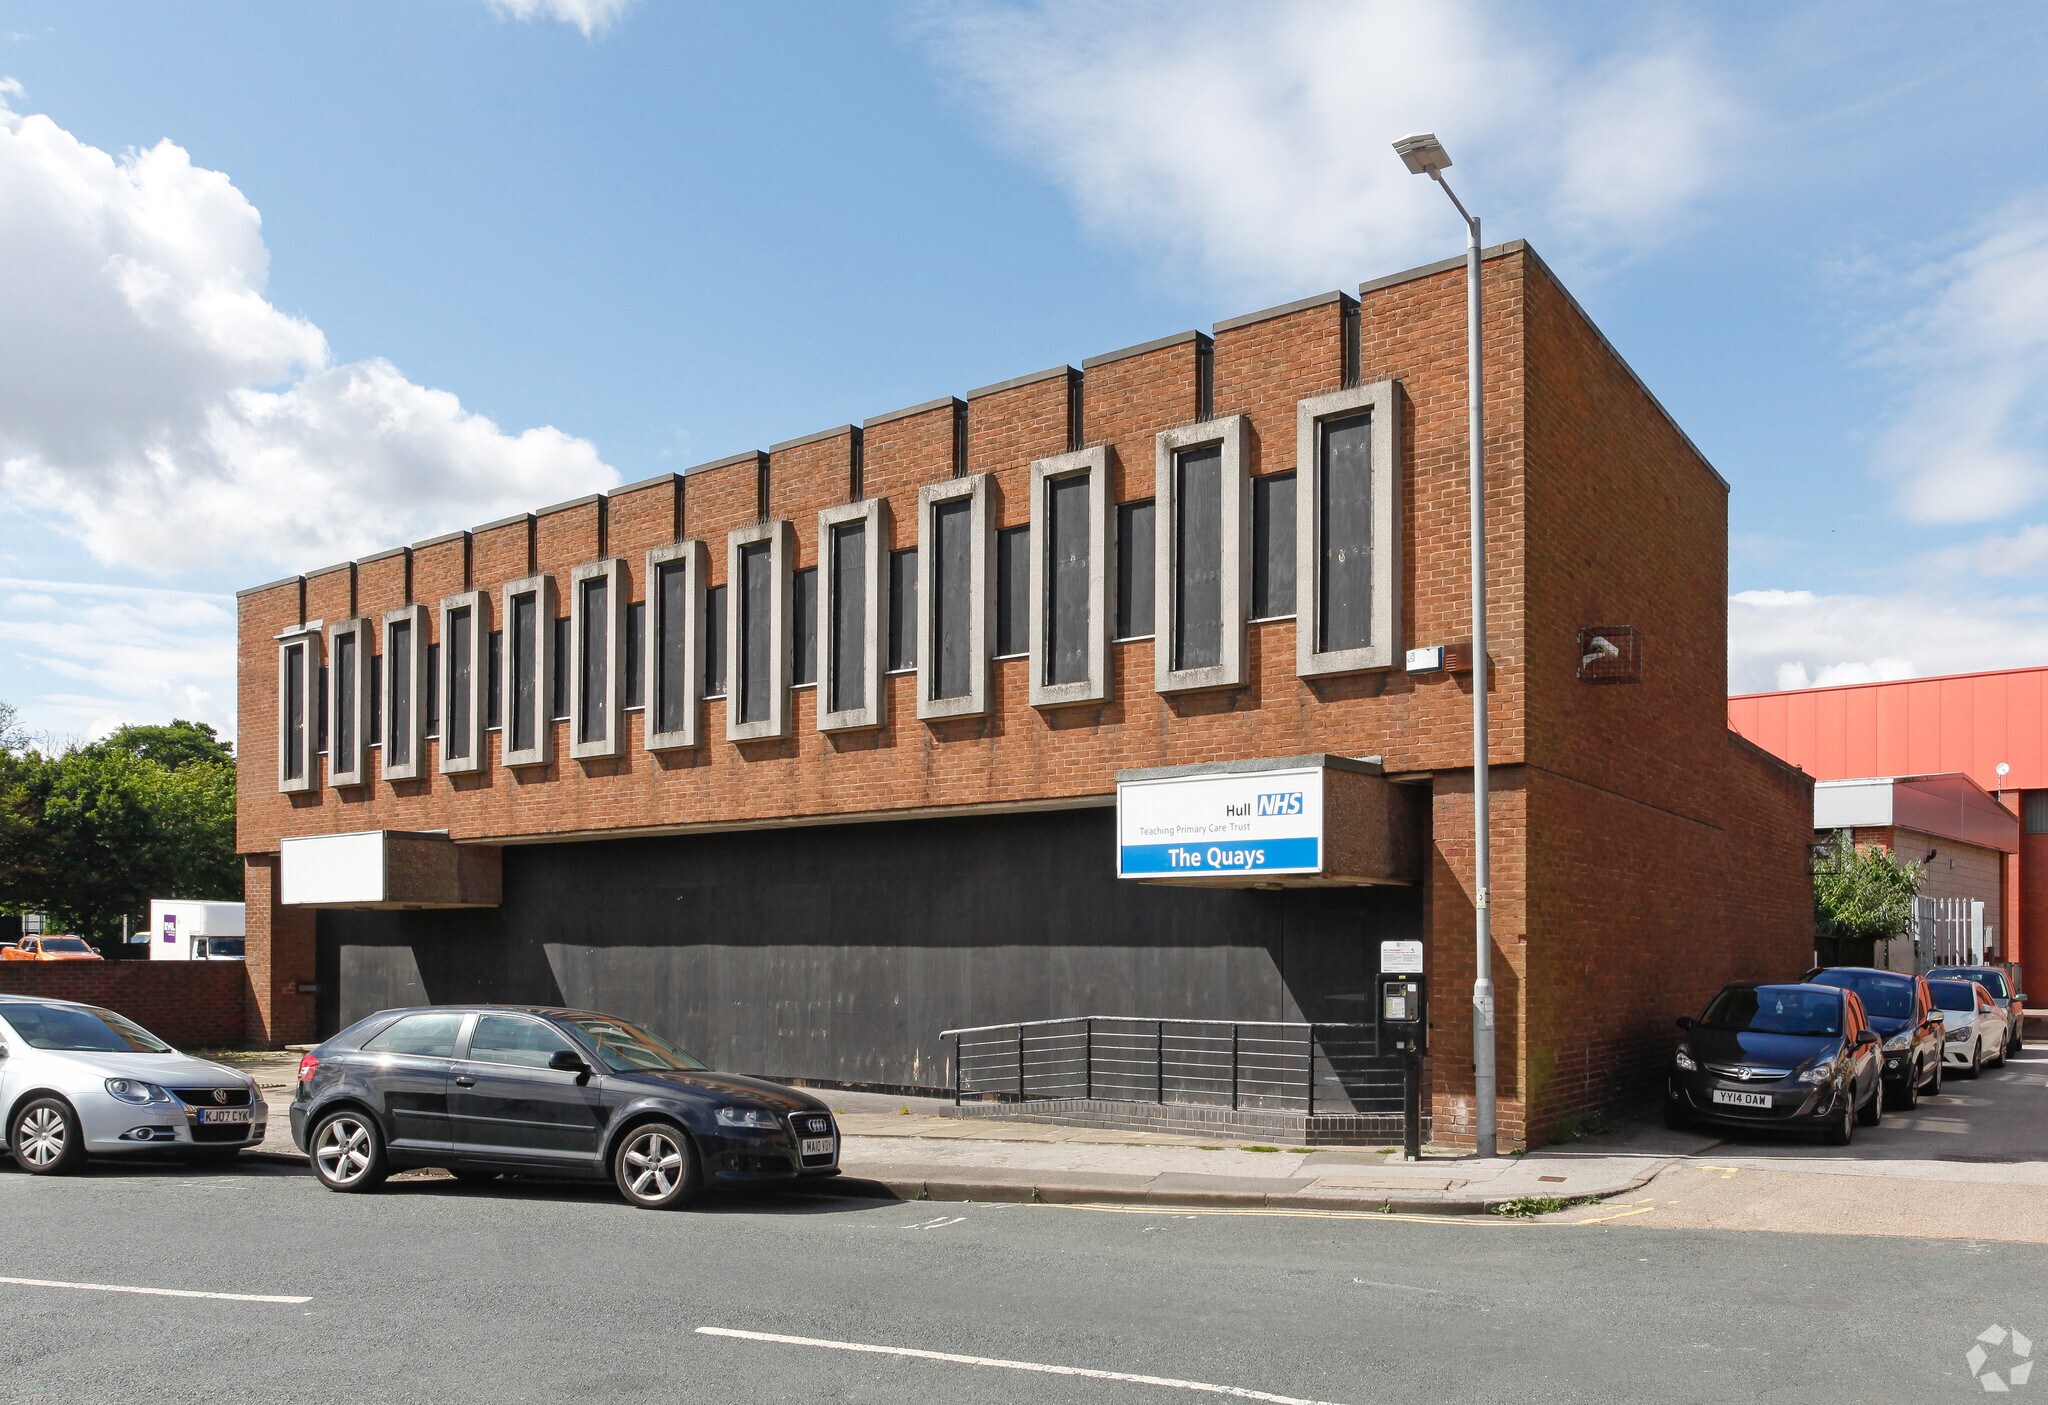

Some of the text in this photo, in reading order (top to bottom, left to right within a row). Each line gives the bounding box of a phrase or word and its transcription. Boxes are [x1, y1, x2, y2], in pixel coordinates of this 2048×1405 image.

[1226, 793, 1302, 817] Hull NHS
[1140, 822, 1251, 837] Teaching Primary Care Trust
[1168, 846, 1265, 871] The Quays
[1720, 1091, 1766, 1105] YY14 OAW
[205, 1110, 249, 1122] KJ07 CYK
[806, 1140, 821, 1153] MA10
